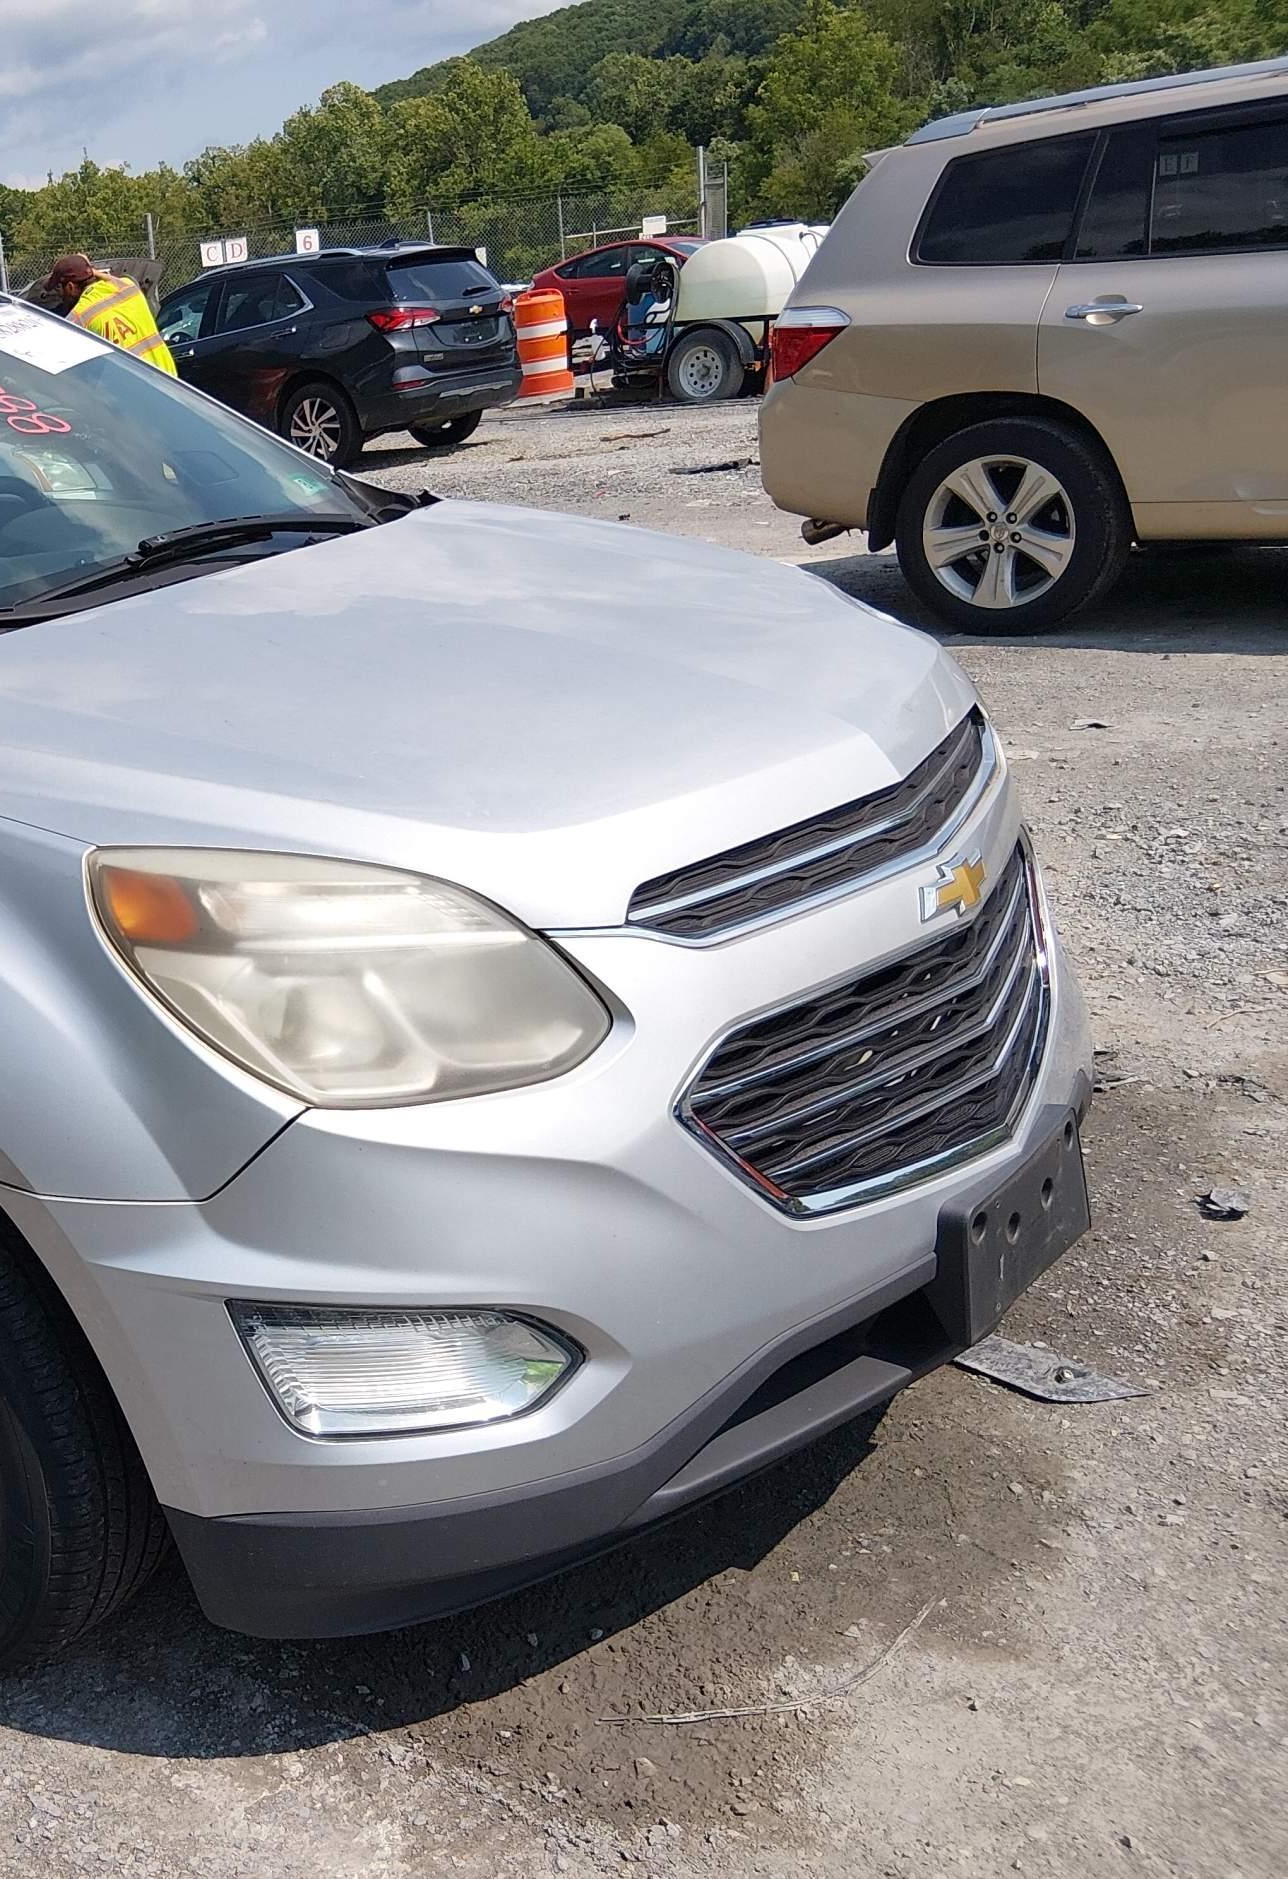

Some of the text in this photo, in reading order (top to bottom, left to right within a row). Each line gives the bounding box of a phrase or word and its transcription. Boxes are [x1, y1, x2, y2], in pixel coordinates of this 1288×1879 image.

[206, 242, 244, 262] C D
[302, 235, 313, 251] 6
